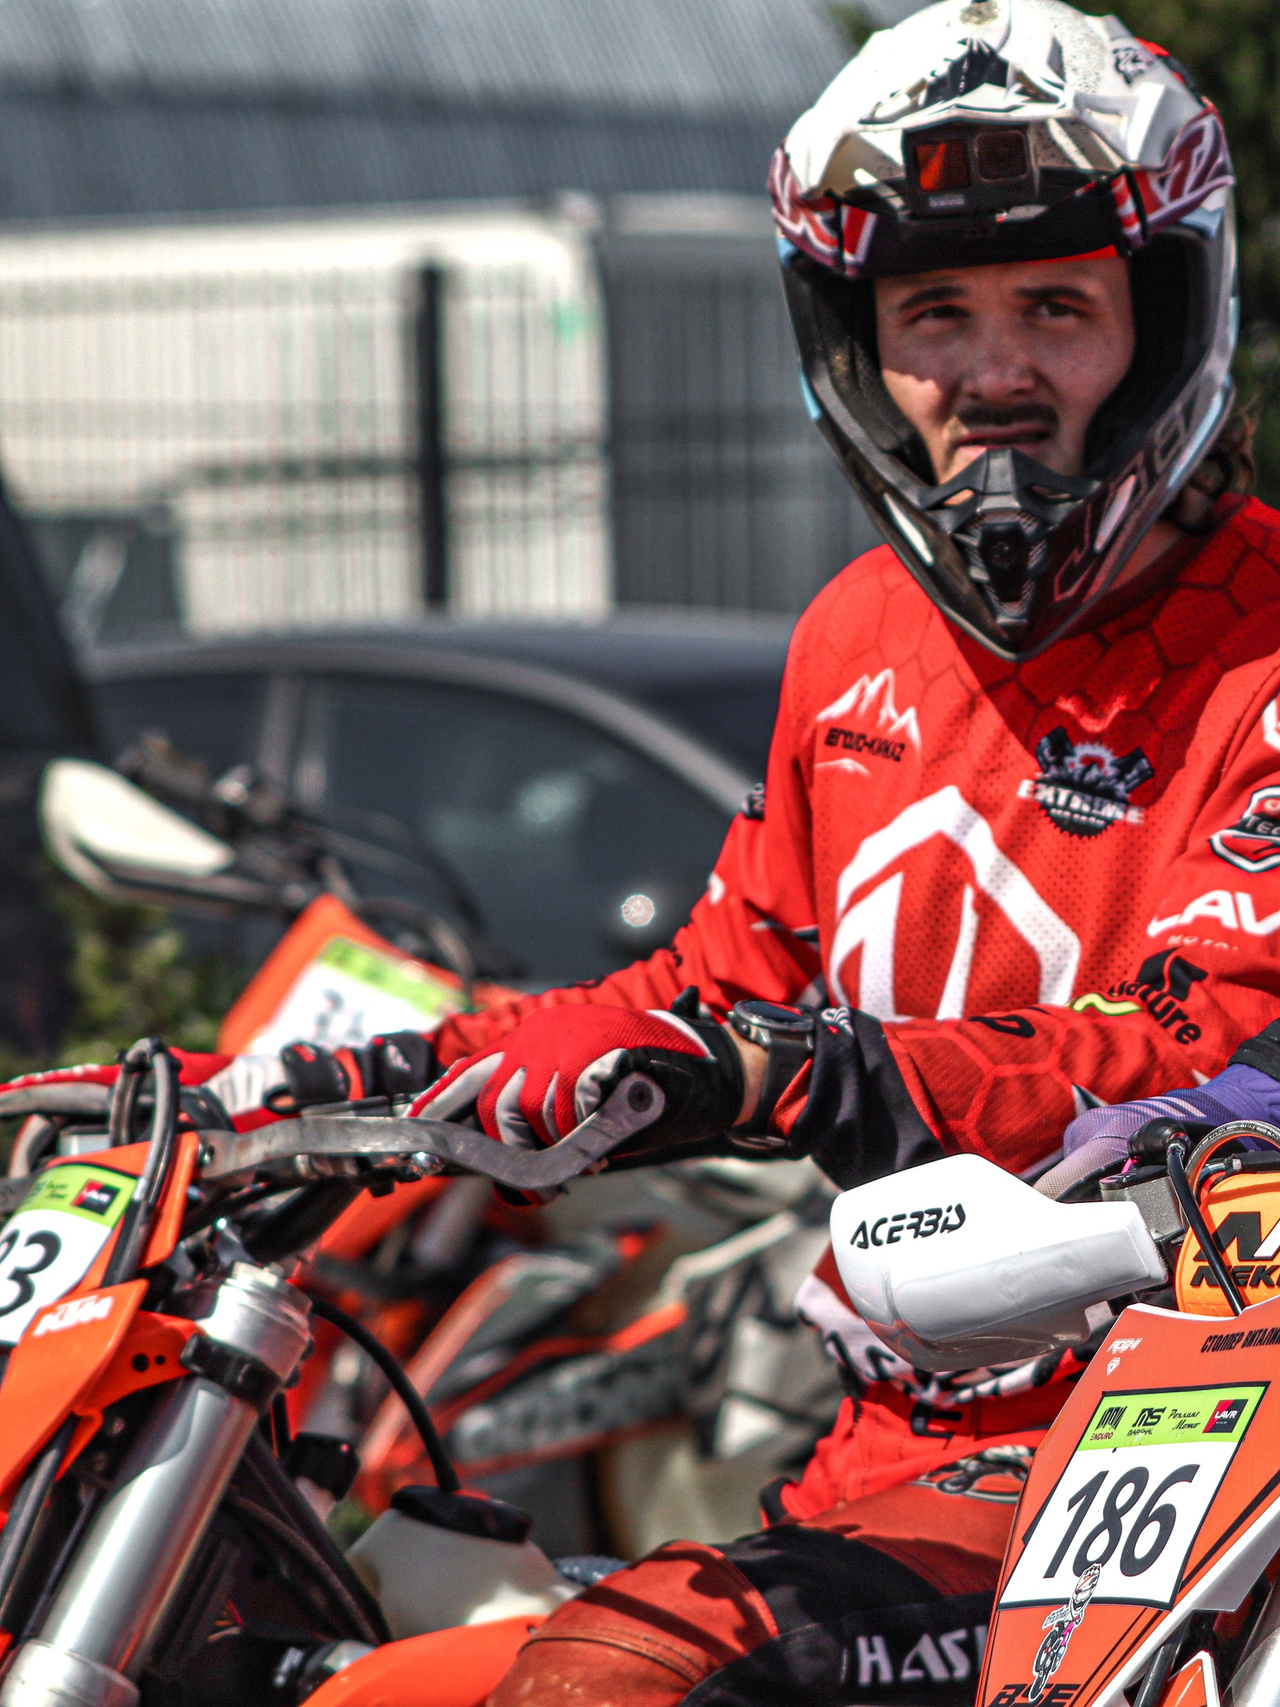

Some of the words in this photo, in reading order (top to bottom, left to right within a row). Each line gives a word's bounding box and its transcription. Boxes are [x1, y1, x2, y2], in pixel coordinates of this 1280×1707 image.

[1214, 1410, 1239, 1419] LAVR
[1090, 1432, 1114, 1442] ENDURO
[1043, 1463, 1201, 1579] 186
